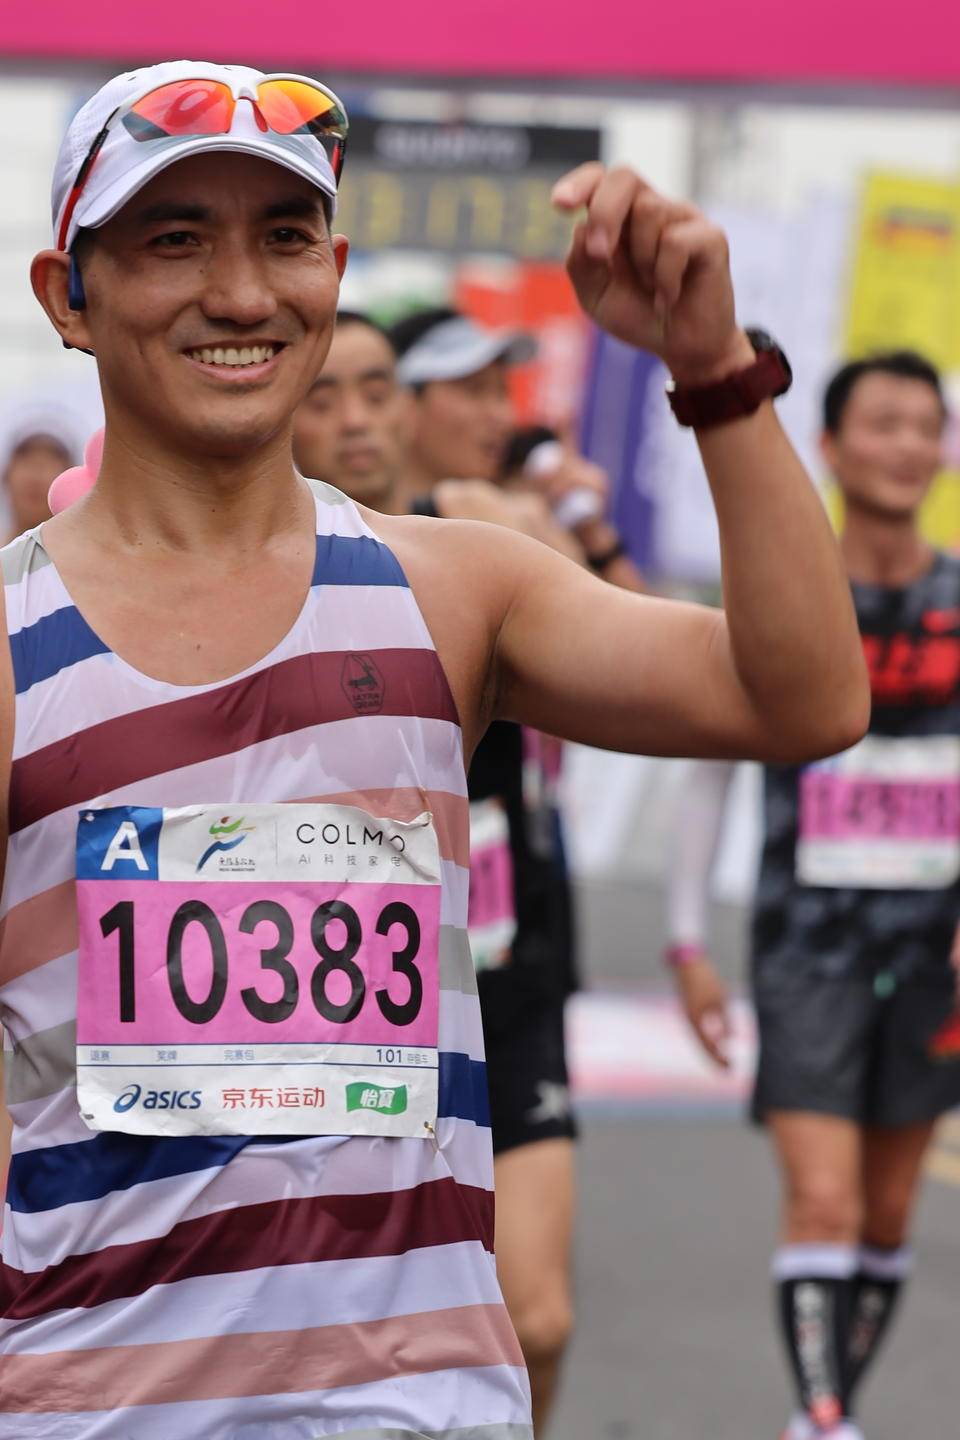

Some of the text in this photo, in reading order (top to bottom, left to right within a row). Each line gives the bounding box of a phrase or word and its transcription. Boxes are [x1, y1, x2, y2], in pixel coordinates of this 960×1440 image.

[100, 821, 150, 872] A
[296, 823, 406, 853] COLMO
[99, 899, 424, 1027] 10383
[376, 1048, 402, 1064] 101
[221, 1087, 326, 1110] 京东运动
